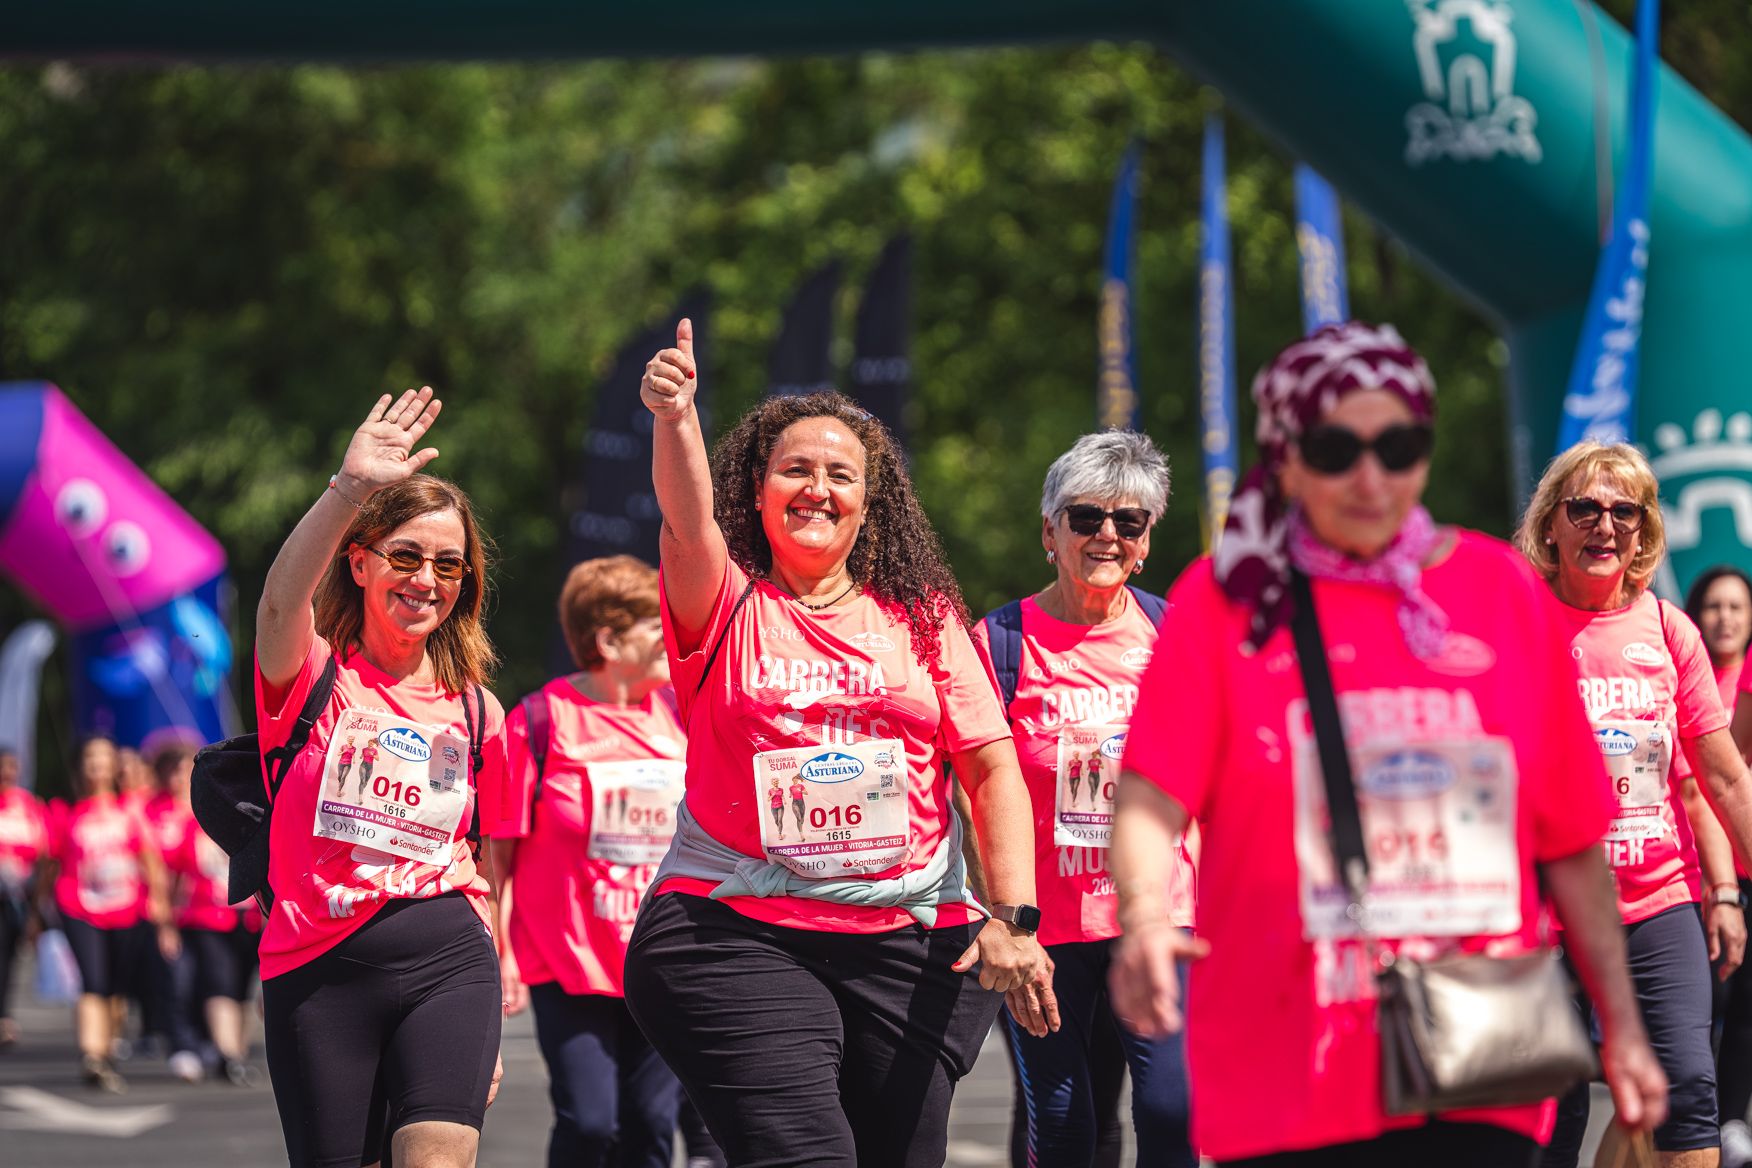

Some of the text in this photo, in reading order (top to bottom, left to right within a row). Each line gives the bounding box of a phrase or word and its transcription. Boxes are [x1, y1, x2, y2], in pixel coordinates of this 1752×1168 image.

[758, 625, 806, 641] YSHO
[751, 655, 887, 695] CARRERA
[1577, 677, 1655, 709] RRERA
[1042, 684, 1139, 726] CARRER
[351, 722, 378, 732] SUMA
[383, 734, 427, 758] ASTURIANA
[1599, 741, 1634, 750] TURIANA
[770, 762, 798, 771] SUMA
[806, 765, 860, 777] ASTURIANA
[373, 776, 421, 806] 016
[384, 804, 406, 818] 1616
[628, 807, 668, 825] 016
[810, 804, 862, 828] 016
[323, 803, 354, 816] CARRERA
[355, 809, 365, 818] DE
[365, 811, 374, 820] LA
[375, 813, 396, 826] MUJER
[400, 821, 448, 840] VITORIA-GASTEIZ
[333, 821, 376, 840] OYSHO
[826, 830, 851, 841] 1615
[1072, 829, 1112, 840] OYSHO
[398, 839, 435, 856] Santander
[801, 846, 810, 854] DE
[811, 845, 820, 853] LA
[821, 842, 843, 851] MUJER
[848, 838, 903, 850] VITORIA-GASTEIZ
